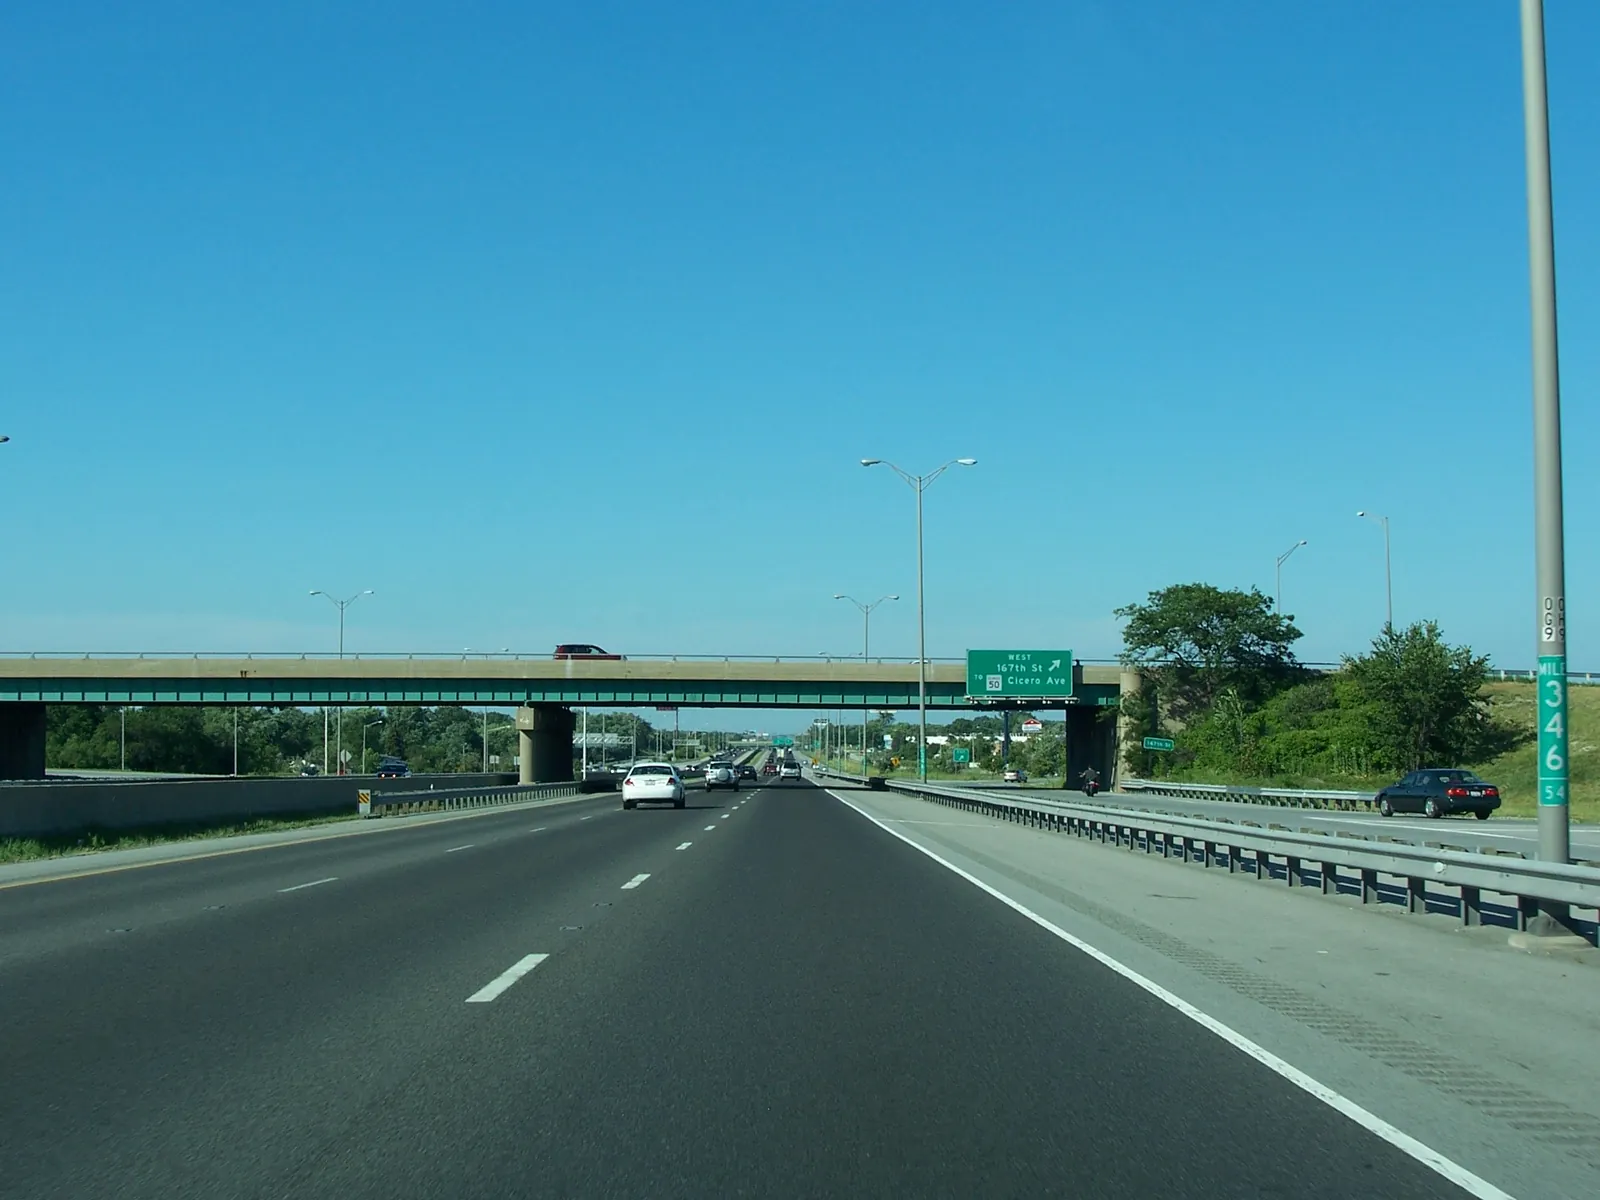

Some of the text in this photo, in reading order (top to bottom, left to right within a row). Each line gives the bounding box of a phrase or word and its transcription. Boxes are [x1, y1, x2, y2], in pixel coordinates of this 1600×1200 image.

[997, 664, 1043, 672] 167th St
[1538, 662, 1565, 676] MILE
[988, 681, 1000, 689] 50
[1007, 676, 1041, 685] Cicero
[1046, 677, 1066, 685] Ave
[1545, 785, 1565, 800] 54
